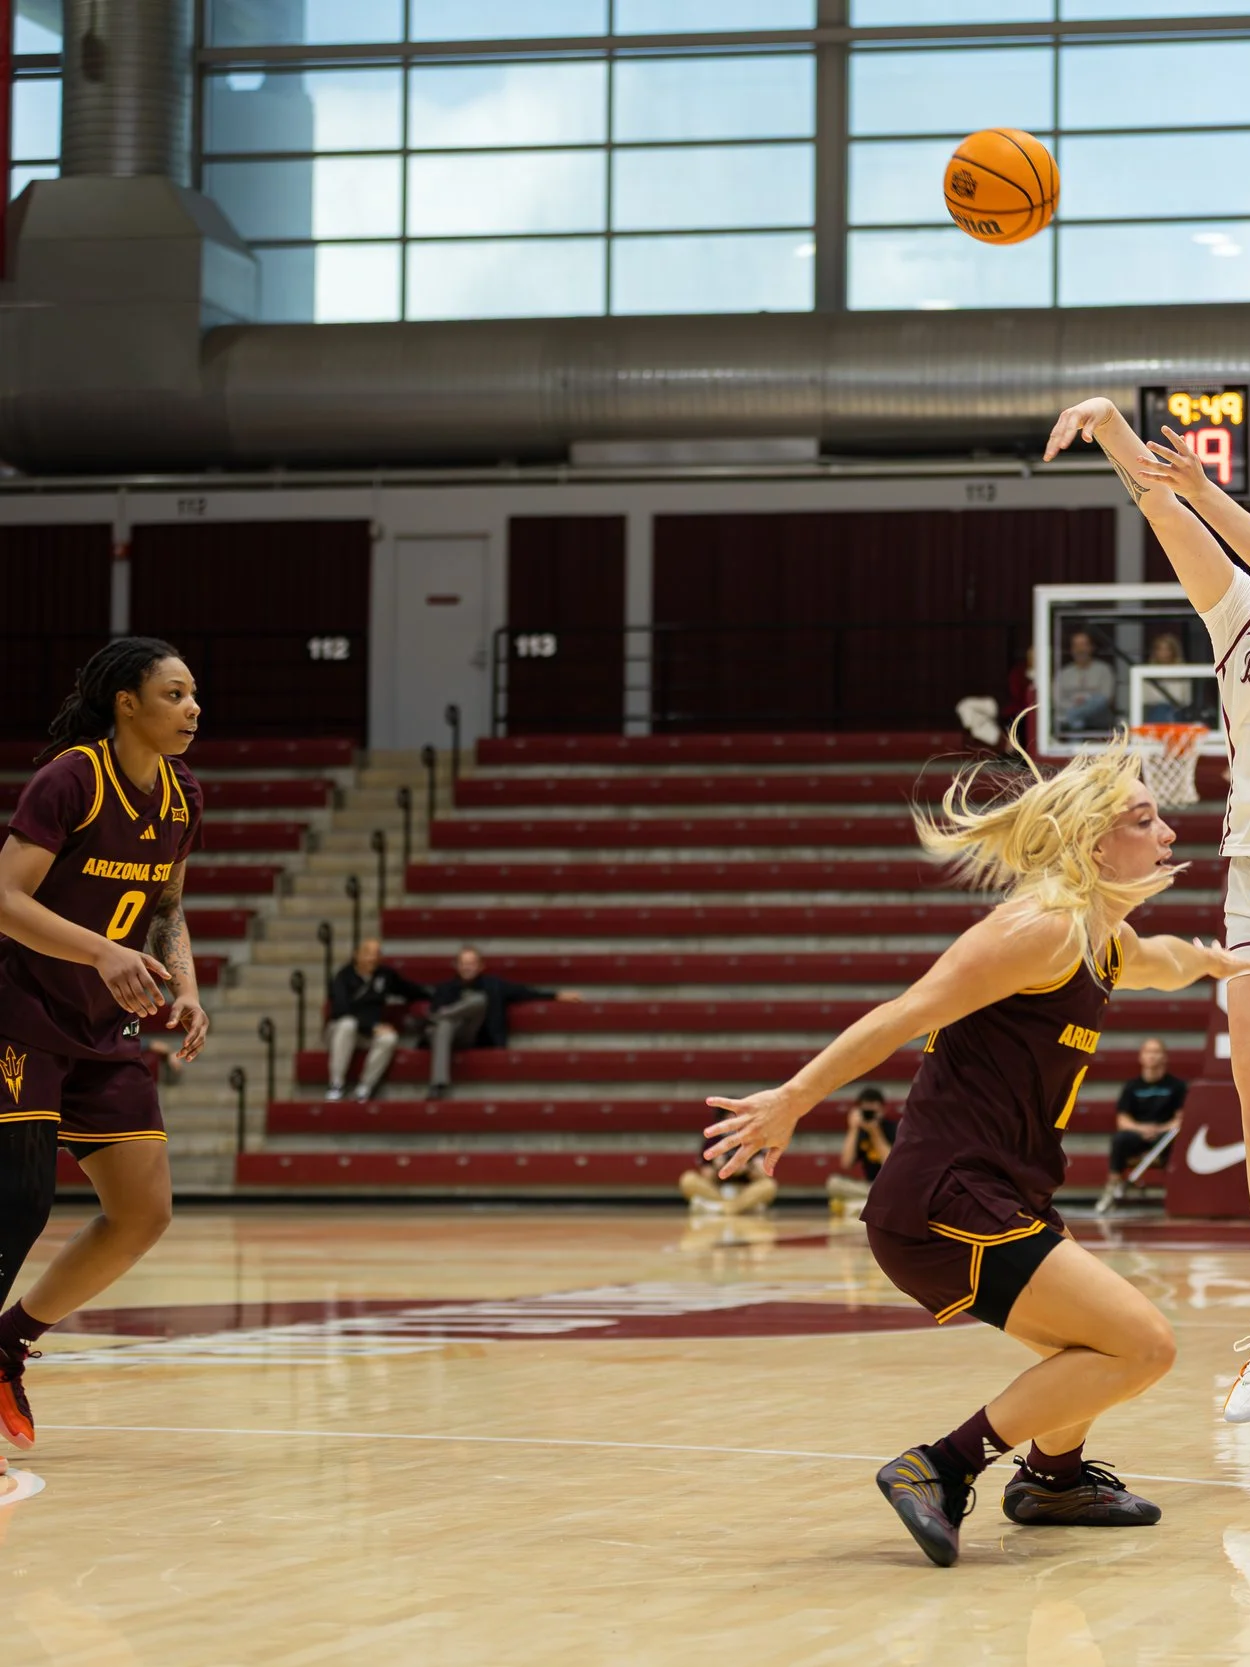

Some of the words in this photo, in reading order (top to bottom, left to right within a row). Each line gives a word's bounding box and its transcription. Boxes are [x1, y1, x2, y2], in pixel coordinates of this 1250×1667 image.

[1168, 391, 1243, 426] 9:49
[1183, 427, 1233, 485] 19
[307, 636, 350, 660] 112
[515, 634, 558, 657] 113
[82, 858, 151, 881] ARIZONA
[106, 890, 147, 940] 0
